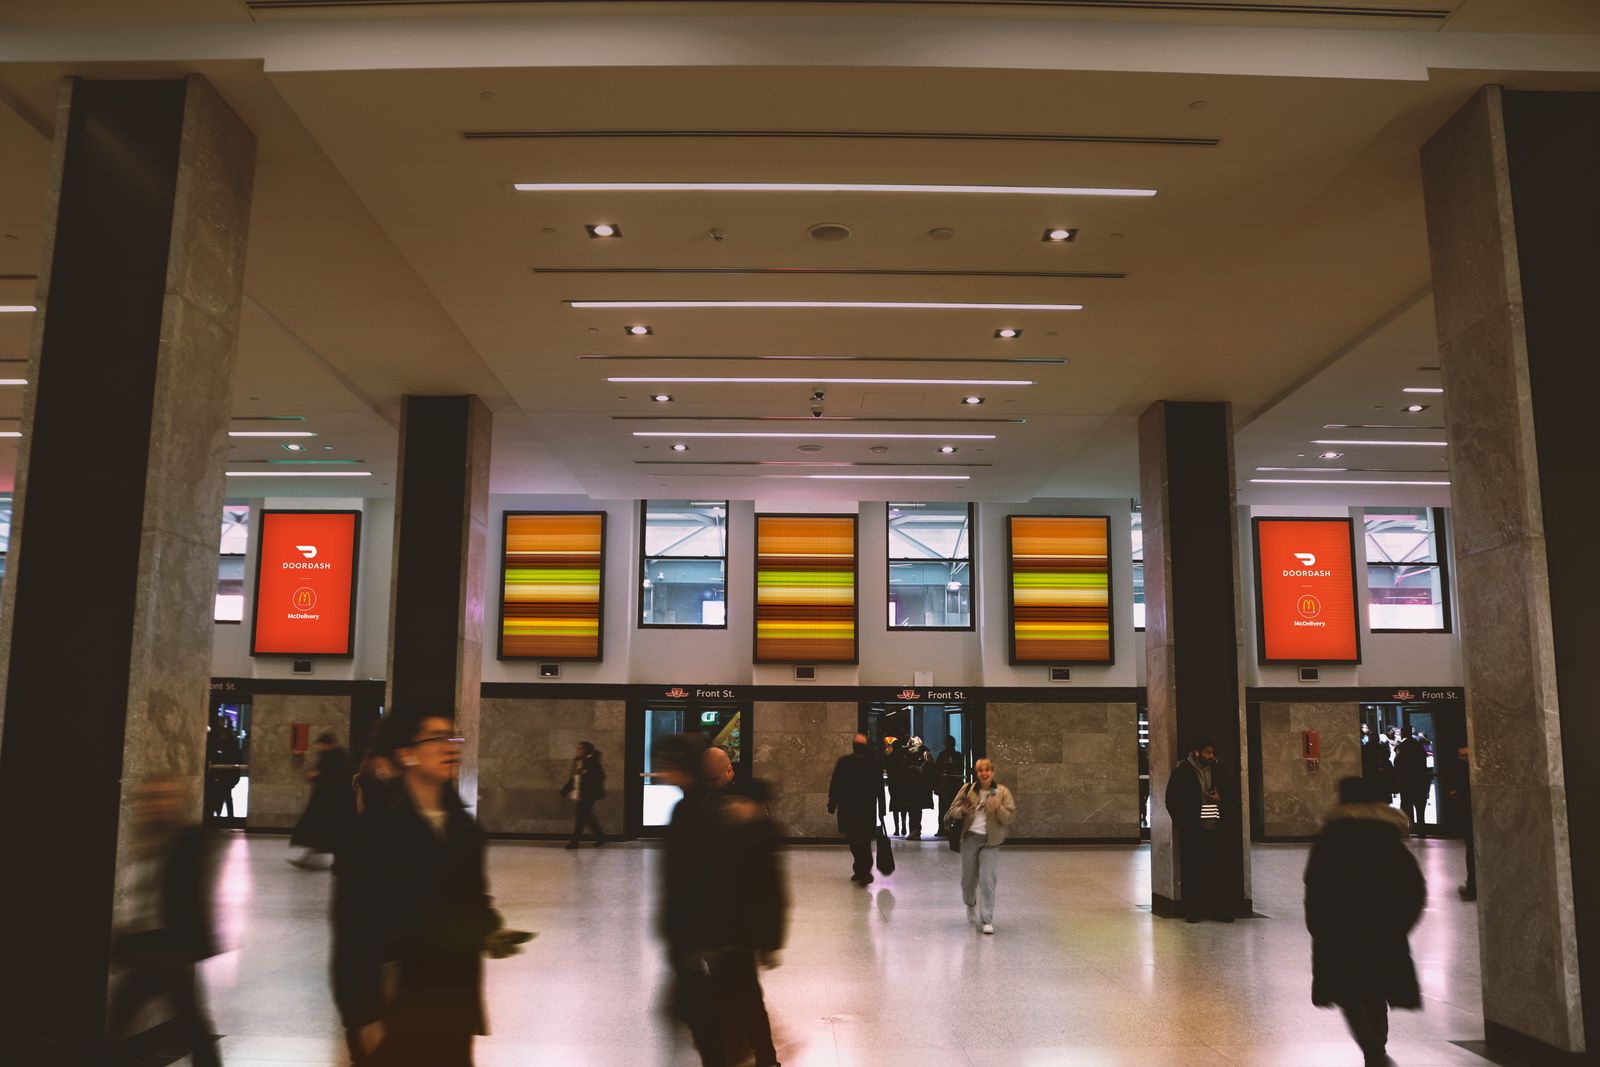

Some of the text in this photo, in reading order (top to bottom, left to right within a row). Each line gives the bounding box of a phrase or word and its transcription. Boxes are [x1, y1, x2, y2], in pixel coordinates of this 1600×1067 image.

[696, 689, 735, 698] Front St.
[927, 691, 966, 699] Front St.
[1421, 691, 1458, 699] Front St.
